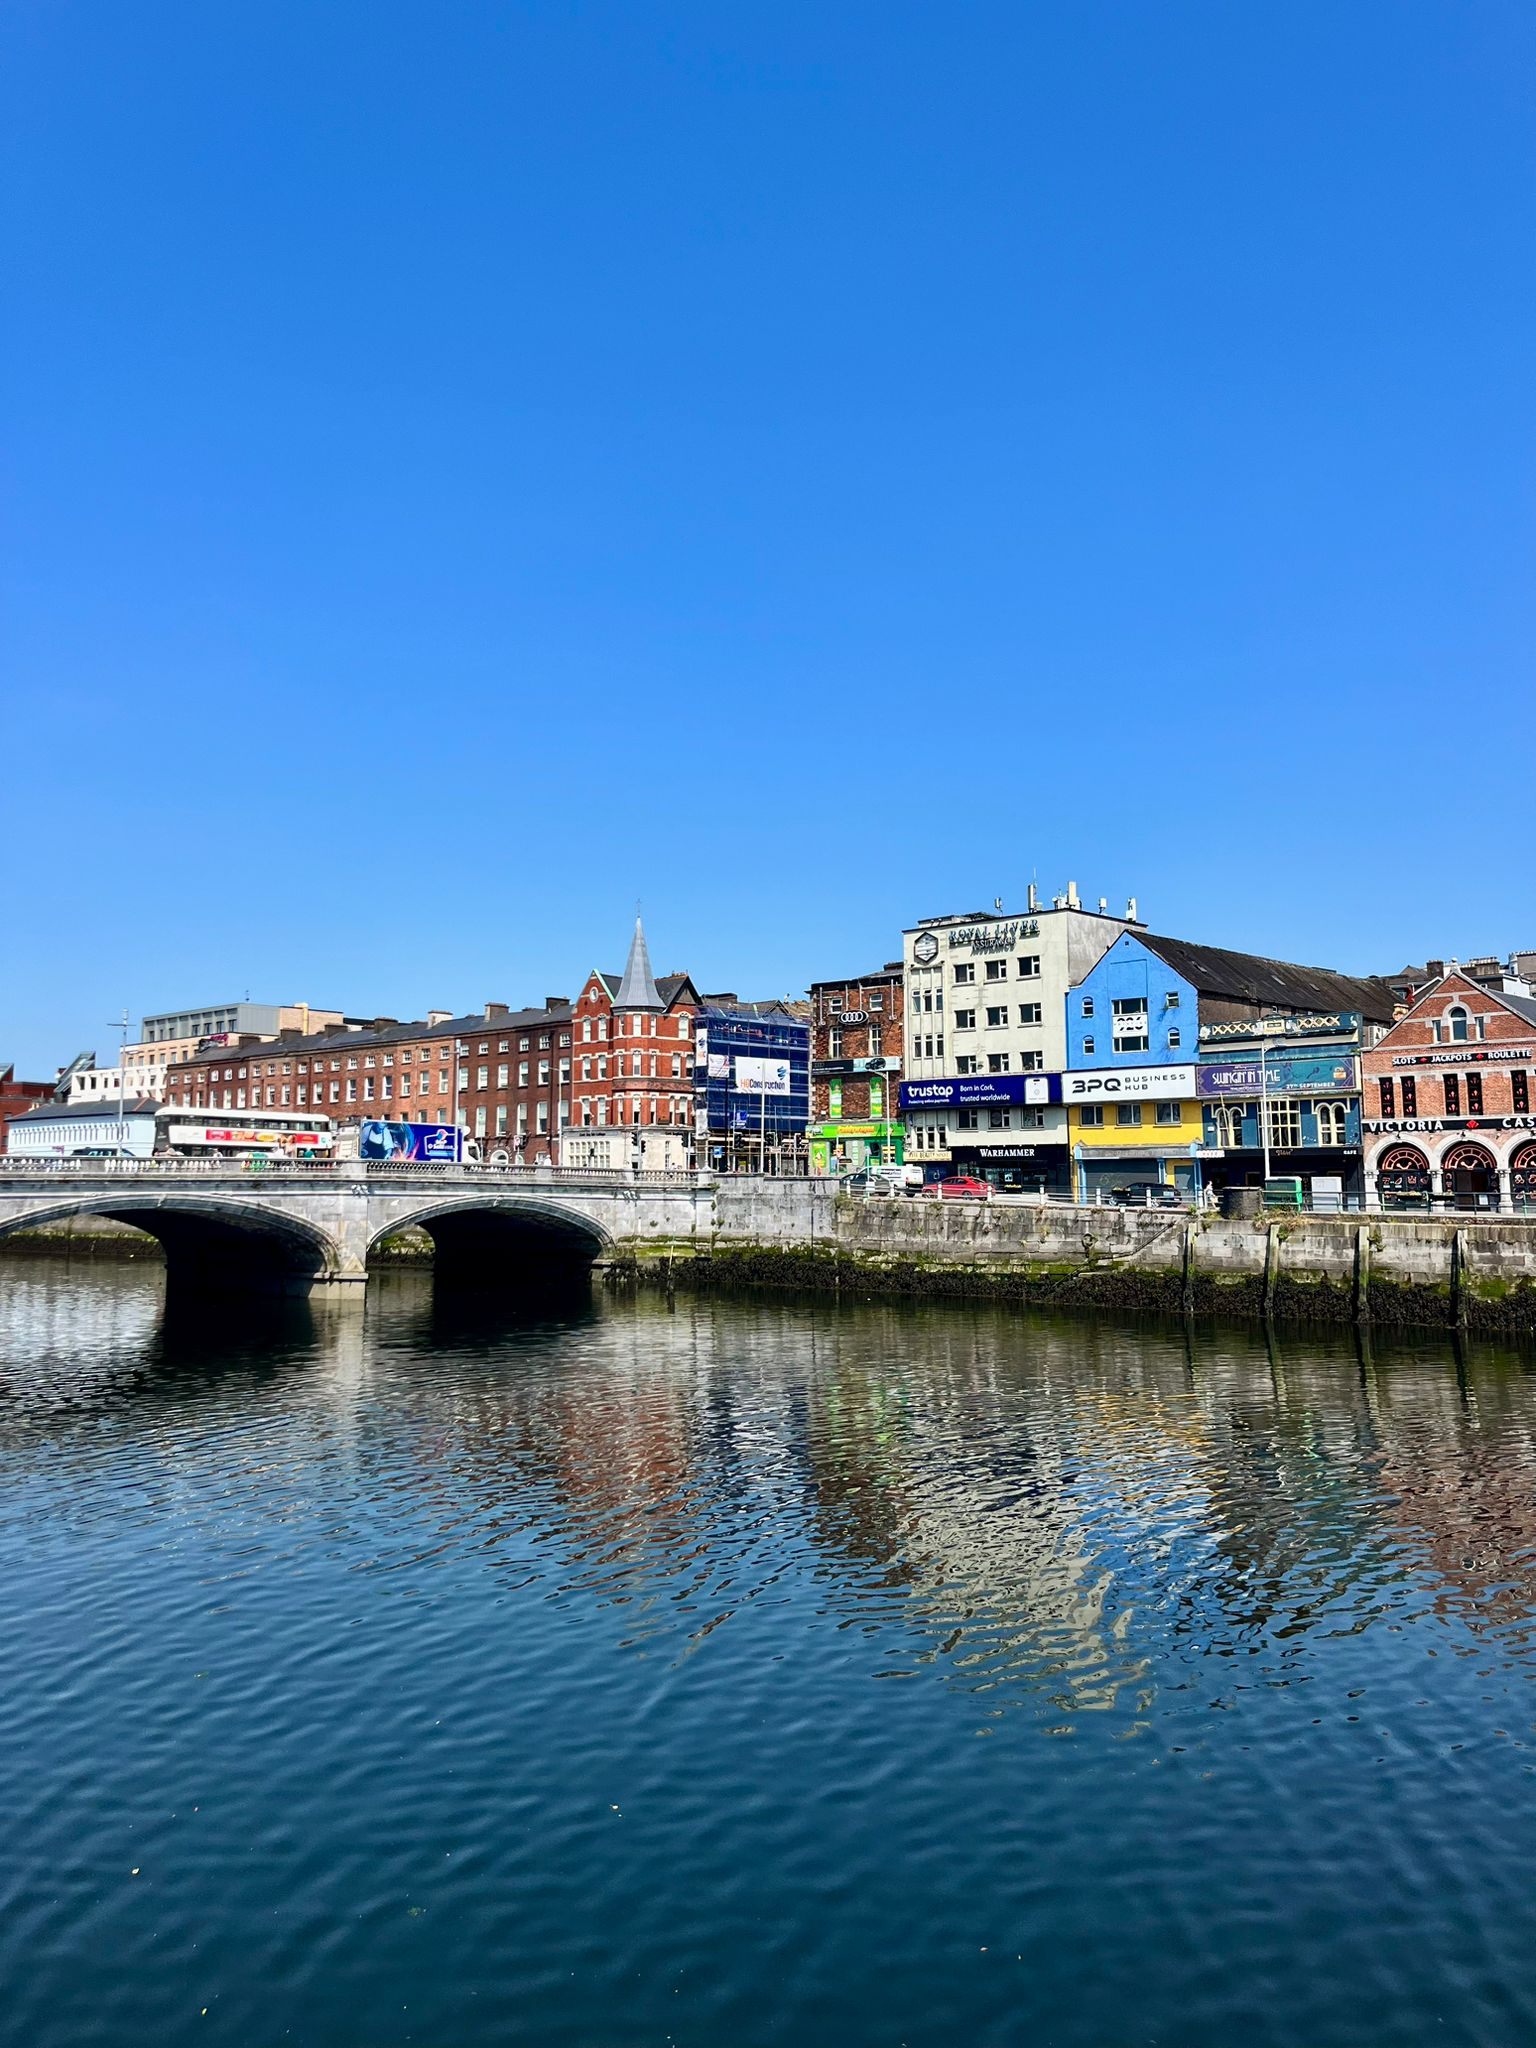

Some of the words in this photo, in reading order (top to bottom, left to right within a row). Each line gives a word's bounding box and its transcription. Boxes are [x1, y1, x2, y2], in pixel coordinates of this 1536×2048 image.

[948, 926, 990, 942] ROYAL
[994, 919, 1039, 936] LIVER
[971, 937, 1017, 950] ASSURANCE
[1392, 1057, 1417, 1066] SLOTS
[1430, 1053, 1472, 1063] JACKPOTS
[1487, 1050, 1532, 1060] ROULETTE
[1125, 1074, 1186, 1083] BUSINESS
[1257, 1069, 1281, 1083] TME
[908, 1084, 953, 1098] trustap
[1072, 1078, 1121, 1094] 3PQ
[980, 1093, 1010, 1101] worldwide
[1368, 1119, 1444, 1132] VICTORIA
[980, 1149, 1035, 1158] WARHAMMER
